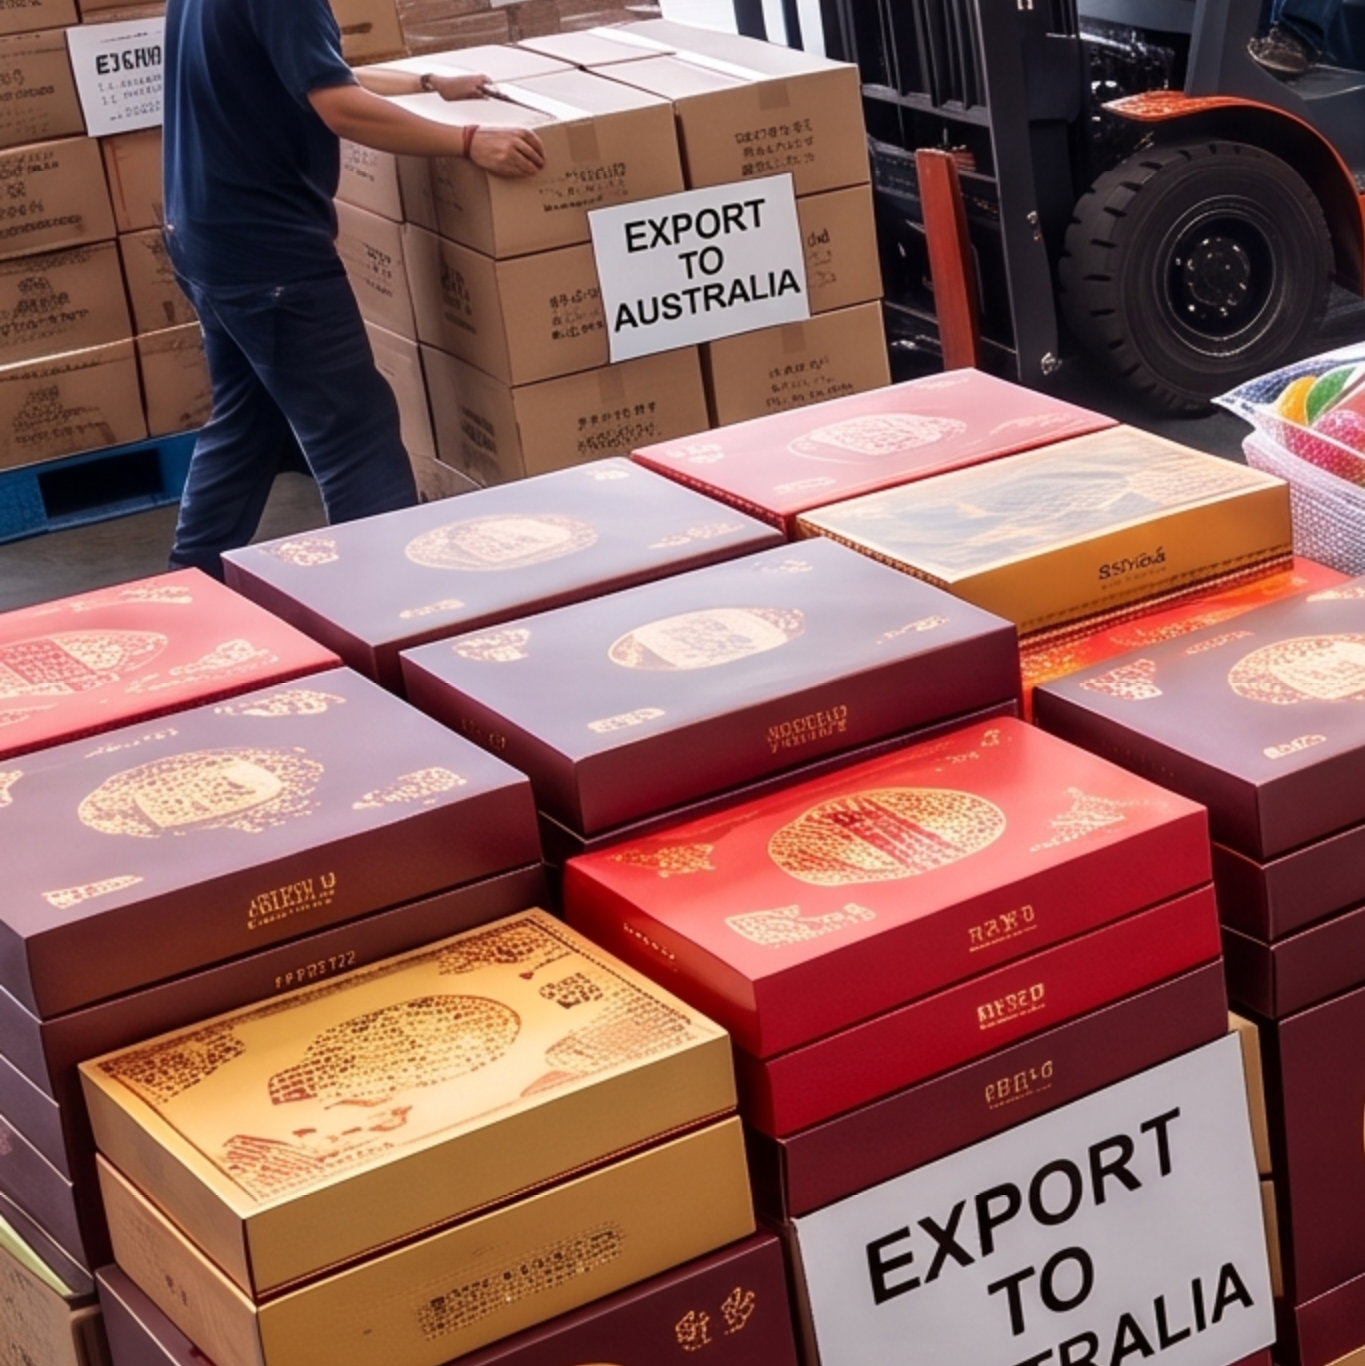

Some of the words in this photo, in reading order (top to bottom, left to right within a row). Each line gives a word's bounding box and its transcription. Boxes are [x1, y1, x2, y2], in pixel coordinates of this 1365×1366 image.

[625, 199, 765, 253] EXPORT
[678, 246, 723, 279] TO
[615, 269, 800, 332] AUSTRALIA
[866, 1107, 1180, 1305] EXPORT
[988, 1247, 1093, 1335] TO
